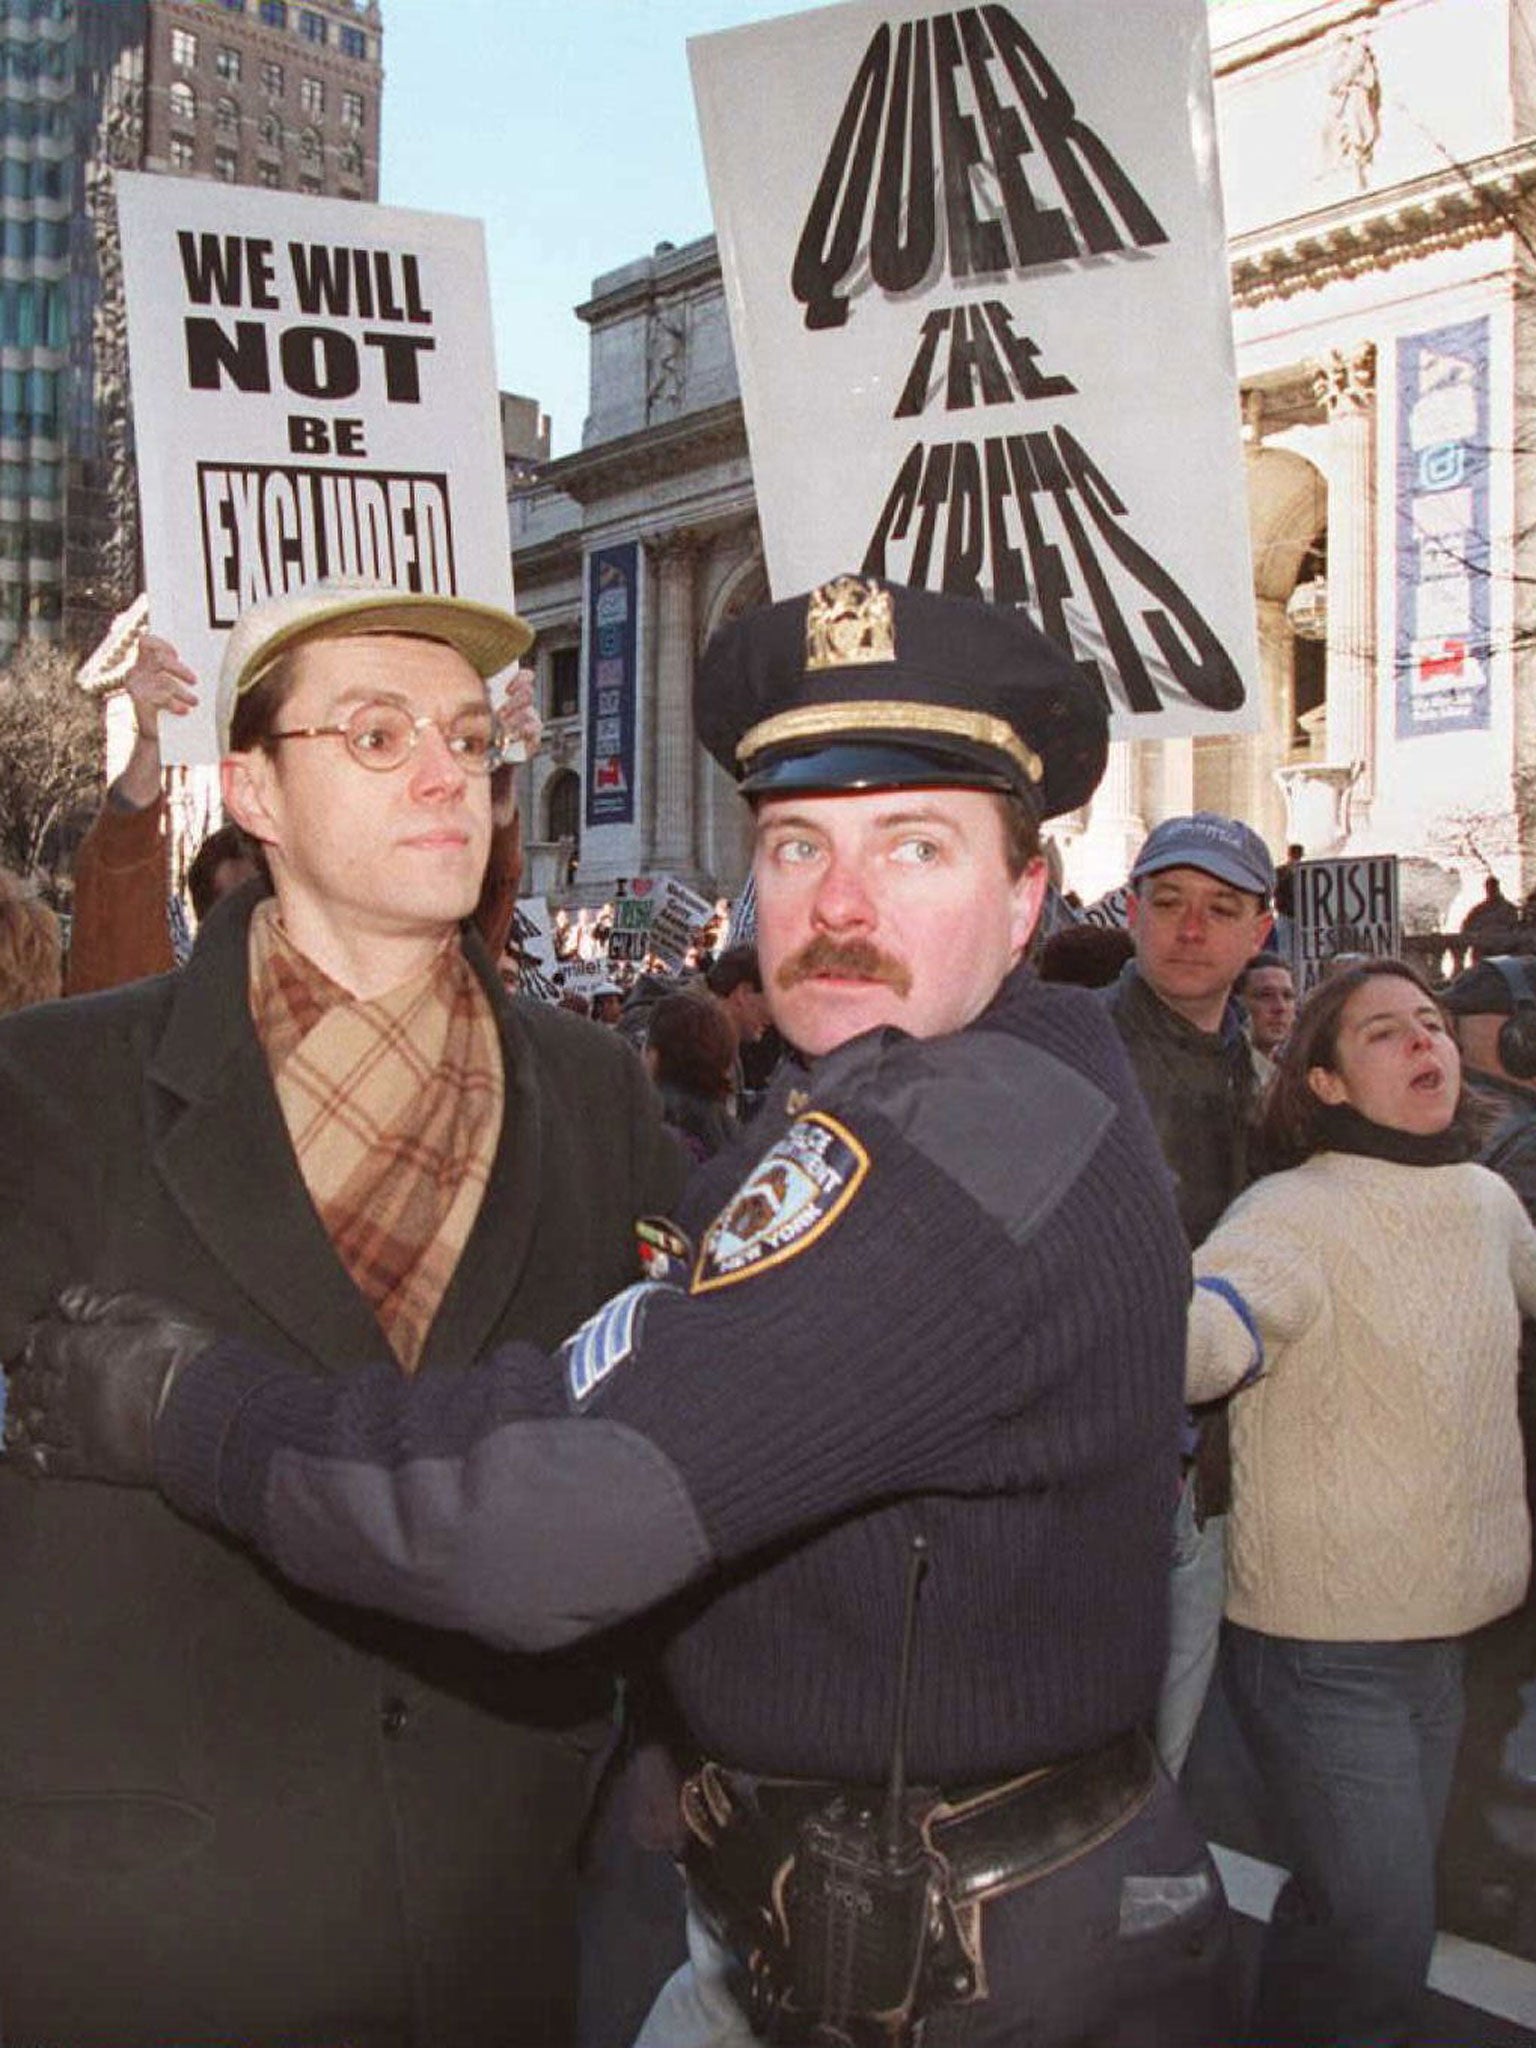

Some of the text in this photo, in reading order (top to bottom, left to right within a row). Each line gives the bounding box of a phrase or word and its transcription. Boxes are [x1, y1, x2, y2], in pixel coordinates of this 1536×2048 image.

[791, 3, 1170, 330] QUEER
[176, 229, 433, 324] WE WILL
[184, 316, 436, 404] NOT
[893, 300, 1079, 420] THE
[287, 415, 367, 458] BE
[203, 468, 456, 625] EXCLUDED
[1300, 862, 1392, 927] IRISH
[762, 1203, 824, 1248] YORK
